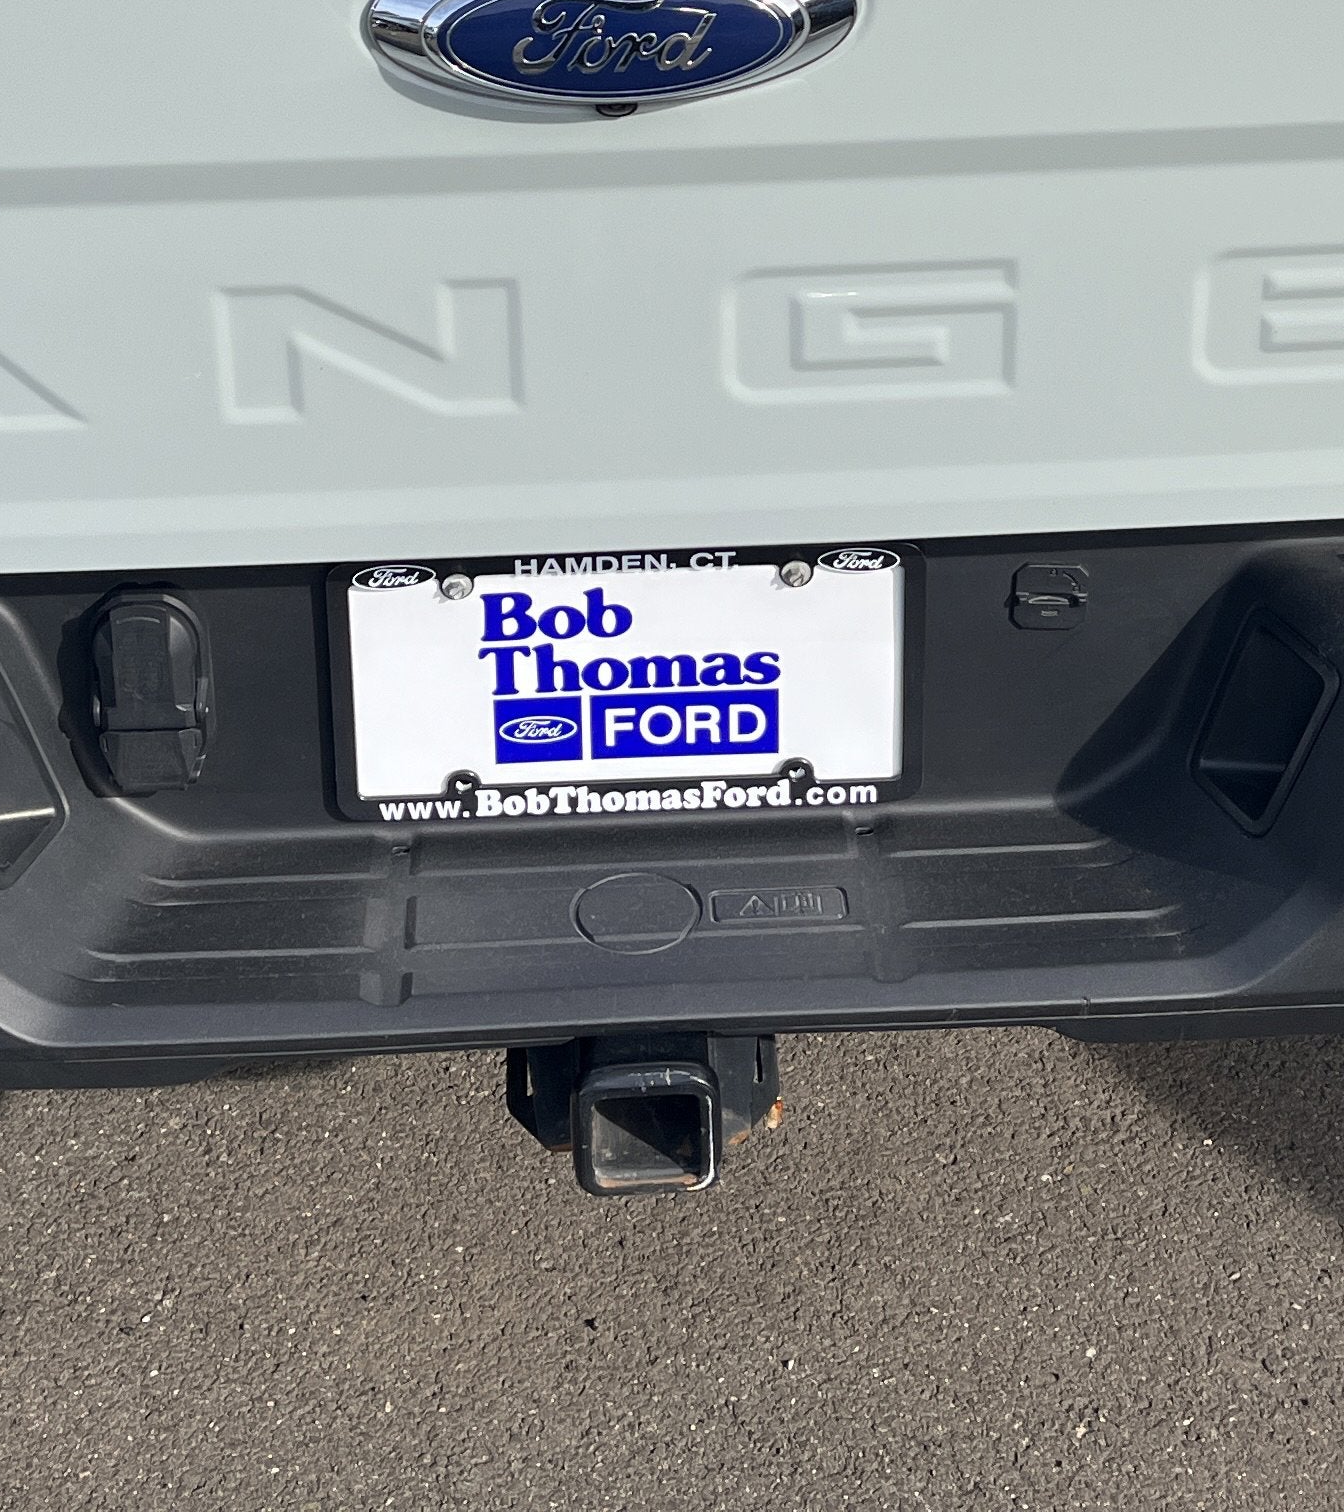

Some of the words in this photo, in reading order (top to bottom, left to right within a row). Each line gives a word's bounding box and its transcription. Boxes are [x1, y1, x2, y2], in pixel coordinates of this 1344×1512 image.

[367, 568, 419, 588] Ford
[832, 551, 885, 570] Ford
[479, 586, 634, 643] Bob
[477, 643, 782, 696] Thomas
[514, 719, 563, 740] Ford
[605, 703, 767, 747] FORD
[379, 780, 878, 822] www.BobThomasFord.com
